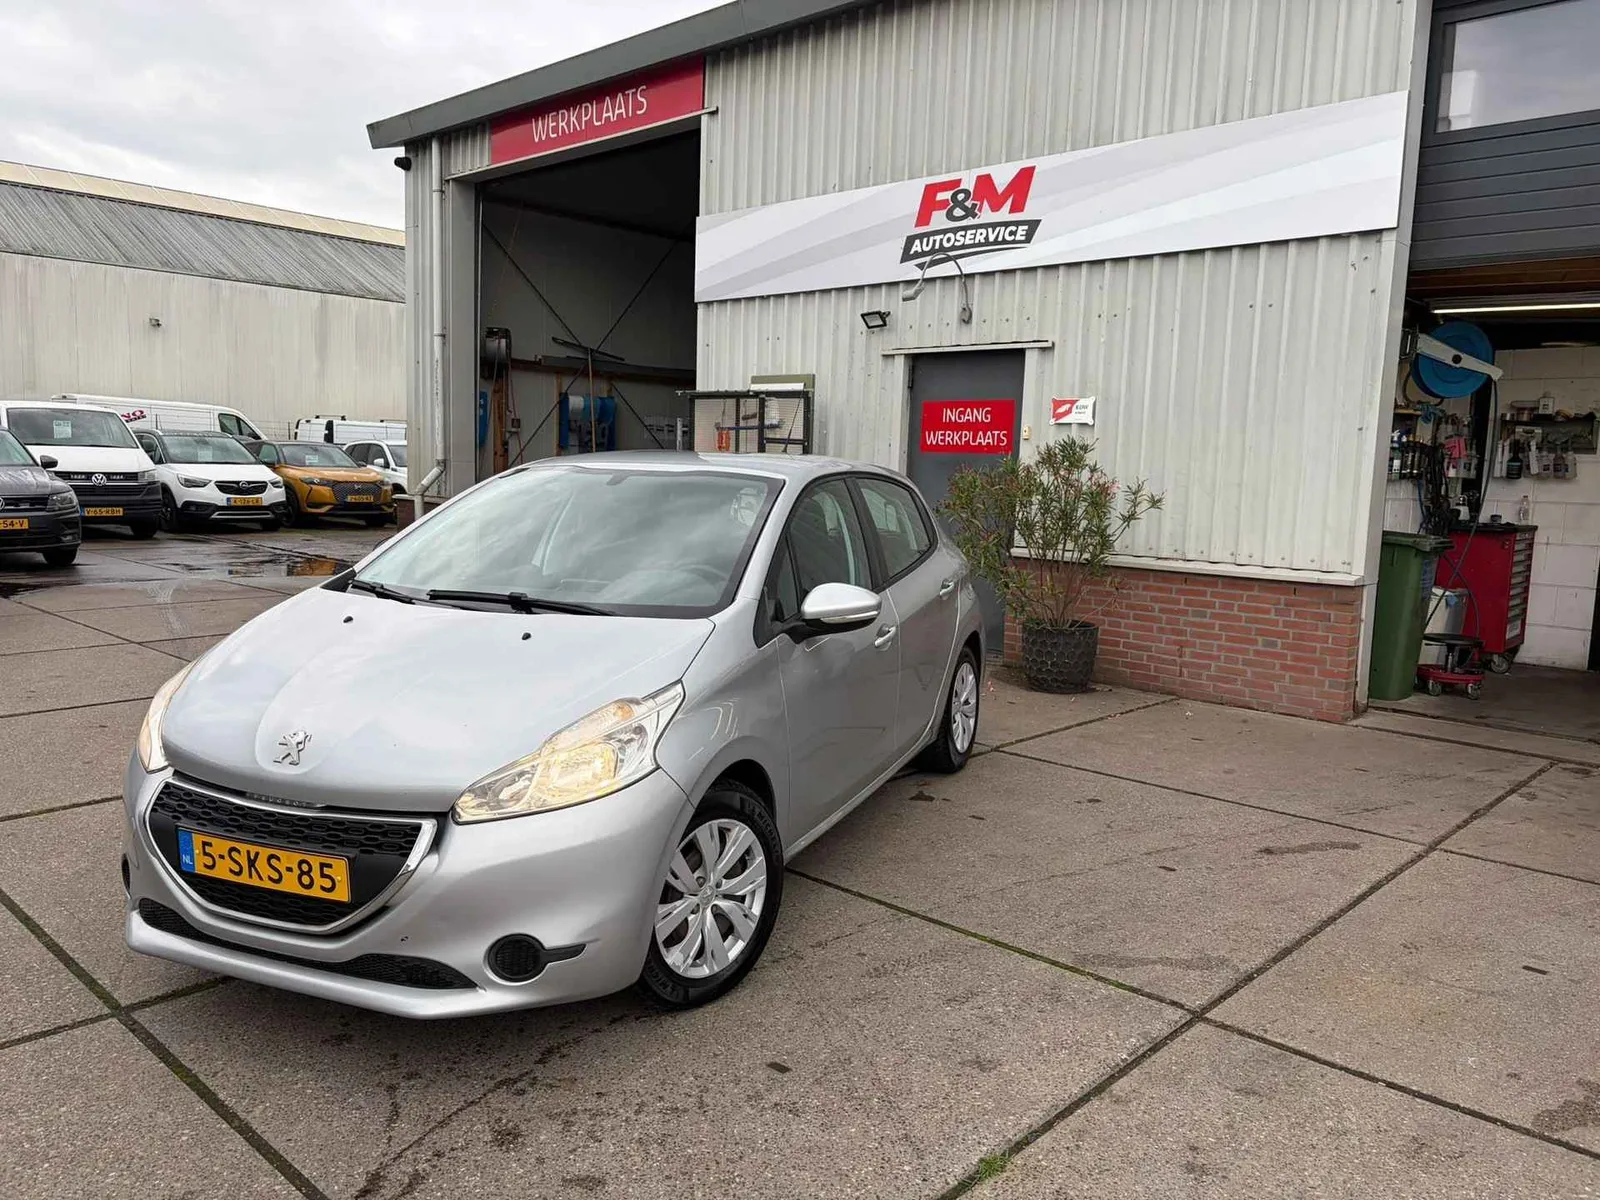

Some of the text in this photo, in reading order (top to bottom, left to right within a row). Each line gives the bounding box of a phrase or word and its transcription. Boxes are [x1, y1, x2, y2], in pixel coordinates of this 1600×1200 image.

[531, 85, 648, 143] WERKPLAATS
[914, 165, 1036, 228] F&M
[909, 225, 1028, 254] AUTOSERVICE
[942, 407, 991, 423] INGANG
[925, 430, 1008, 446] WERKPLAATS
[182, 854, 193, 865] NL
[201, 840, 337, 893] 5-SKS-85
